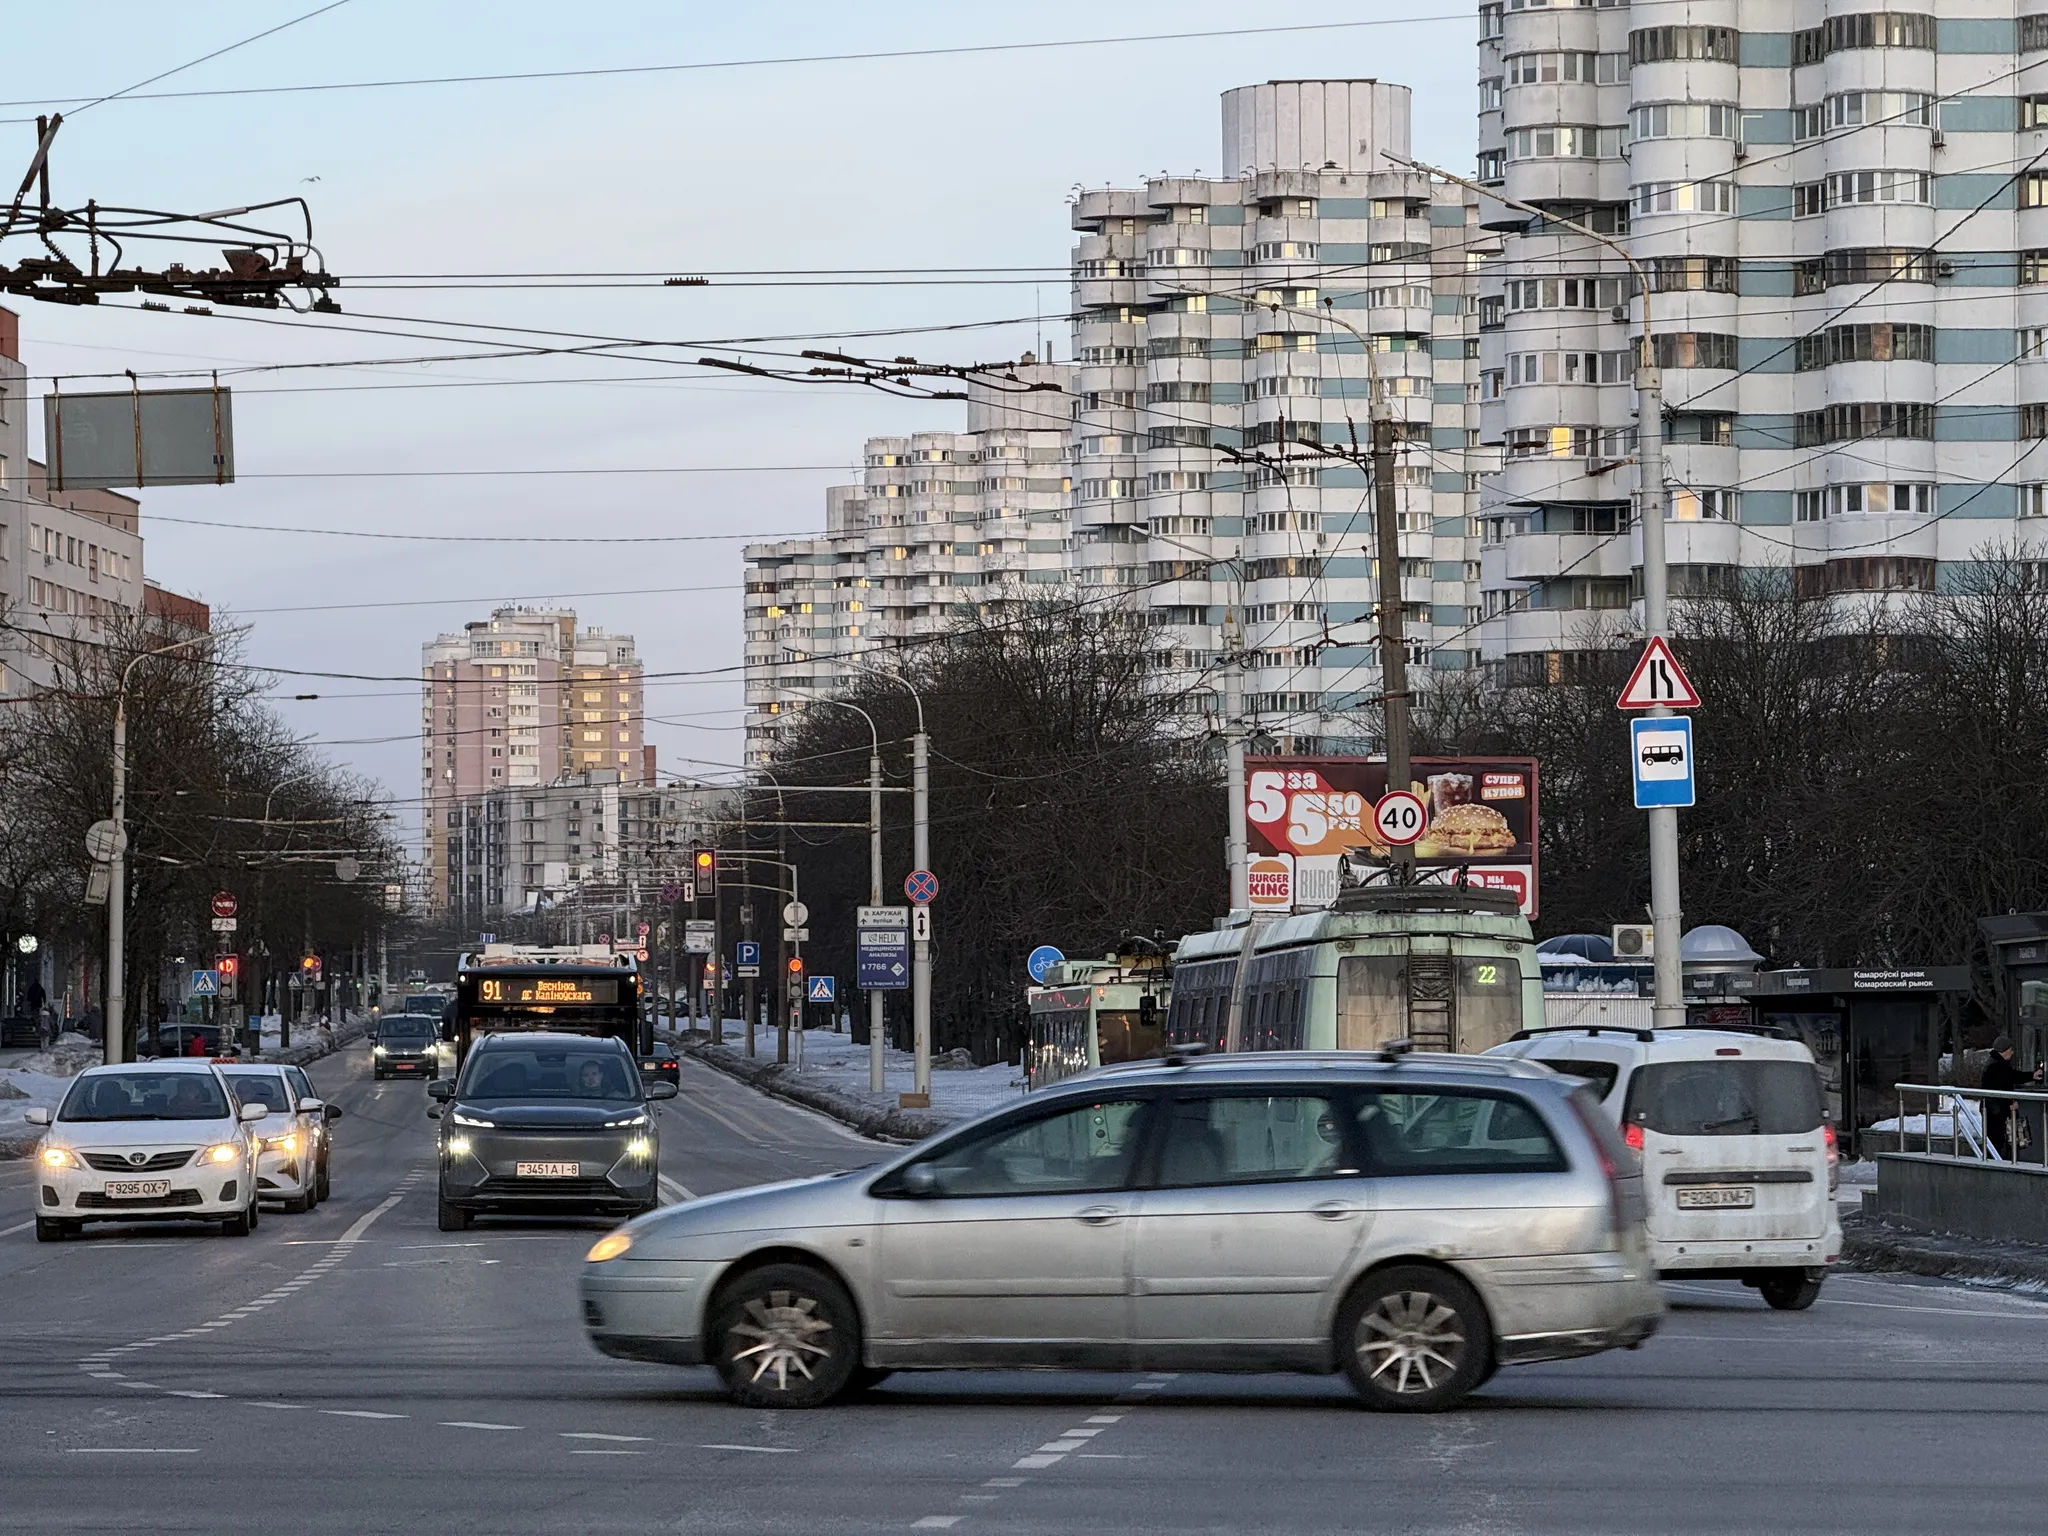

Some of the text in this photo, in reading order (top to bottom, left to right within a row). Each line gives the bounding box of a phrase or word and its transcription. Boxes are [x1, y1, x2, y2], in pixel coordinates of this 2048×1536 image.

[1485, 775, 1520, 785] СУПЕР
[1247, 771, 1287, 823] 5
[1484, 787, 1522, 798] КУПОН
[1288, 793, 1361, 846] 5 50
[1328, 817, 1361, 830] РУБ
[1382, 807, 1417, 829] 40
[1249, 873, 1289, 884] BURGER
[1487, 875, 1504, 884] МЫ
[1249, 883, 1289, 897] KING
[879, 933, 898, 943] HELIX
[743, 946, 755, 962] P
[1478, 966, 1496, 983] 22
[1854, 971, 1925, 979] Камароўскі рынак
[1854, 980, 1934, 988] Комаровский рынок
[482, 980, 502, 1000] 91
[526, 1164, 548, 1175] 3451
[115, 1184, 140, 1194] 9295
